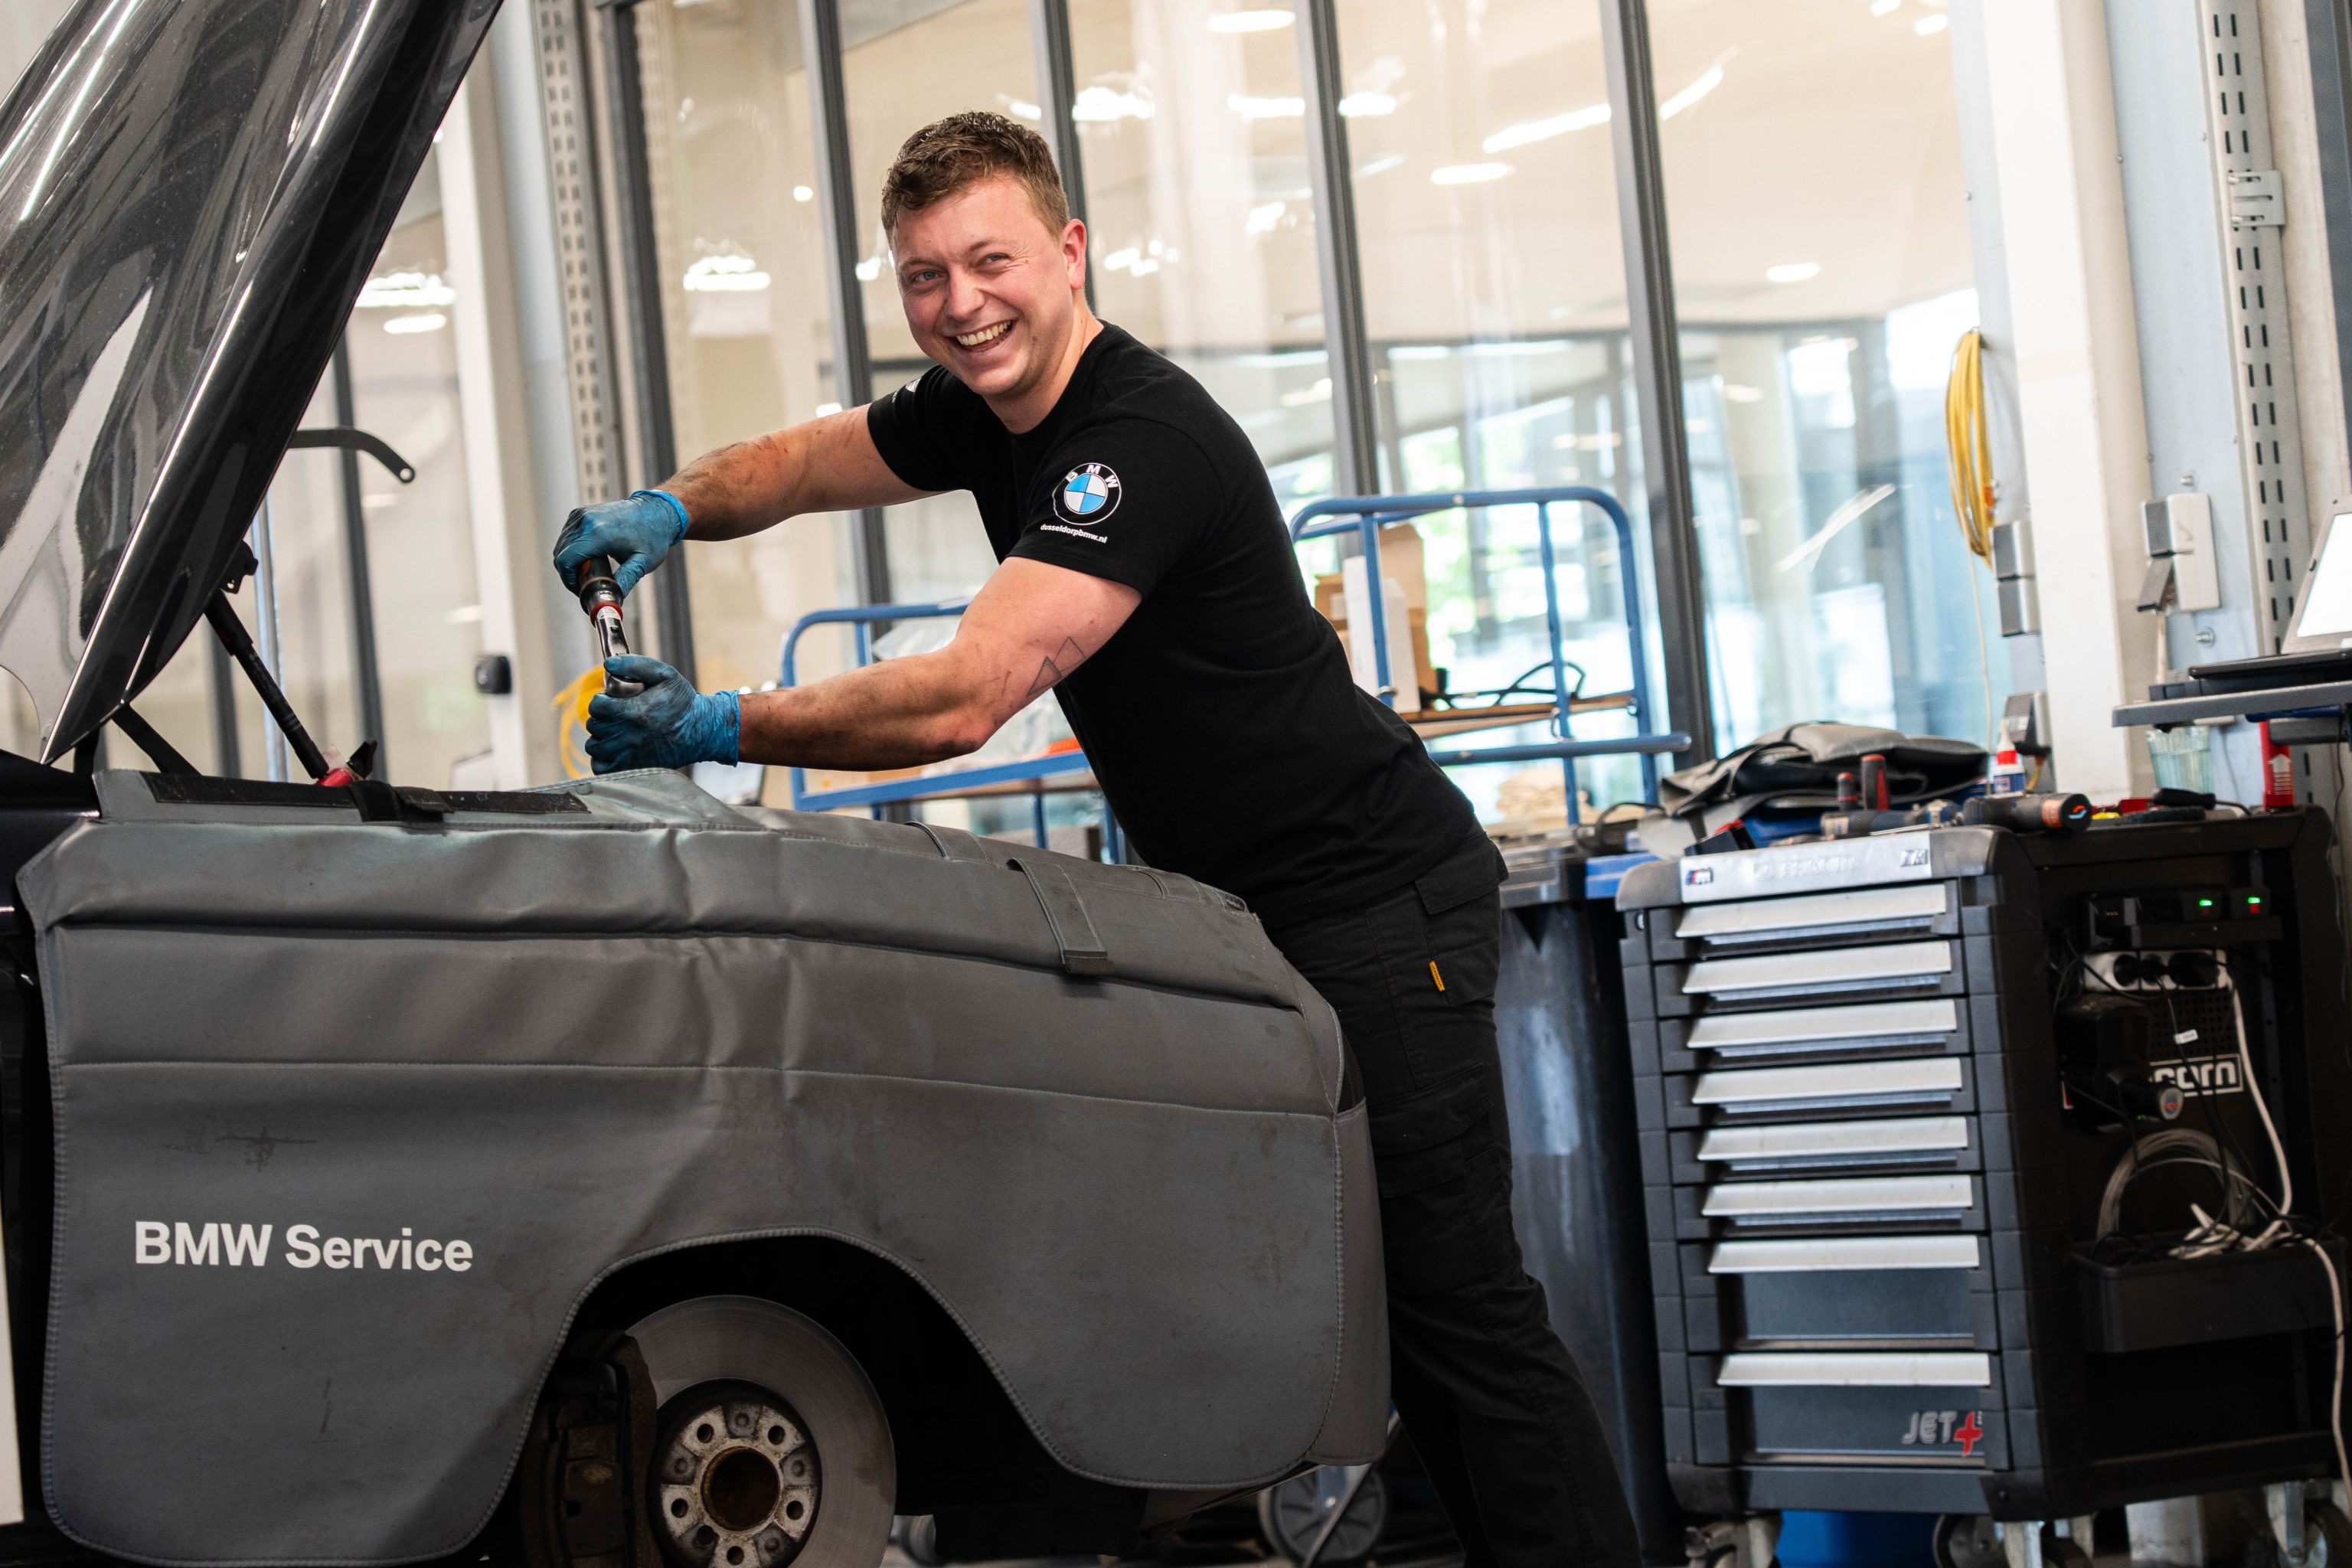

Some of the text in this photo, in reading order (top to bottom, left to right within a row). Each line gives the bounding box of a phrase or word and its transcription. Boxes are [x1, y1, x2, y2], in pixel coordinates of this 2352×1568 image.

[1065, 464, 1119, 488] BMW
[1040, 524, 1108, 543] dusseldorpbmw.nl
[135, 1220, 474, 1272] BMW Service
